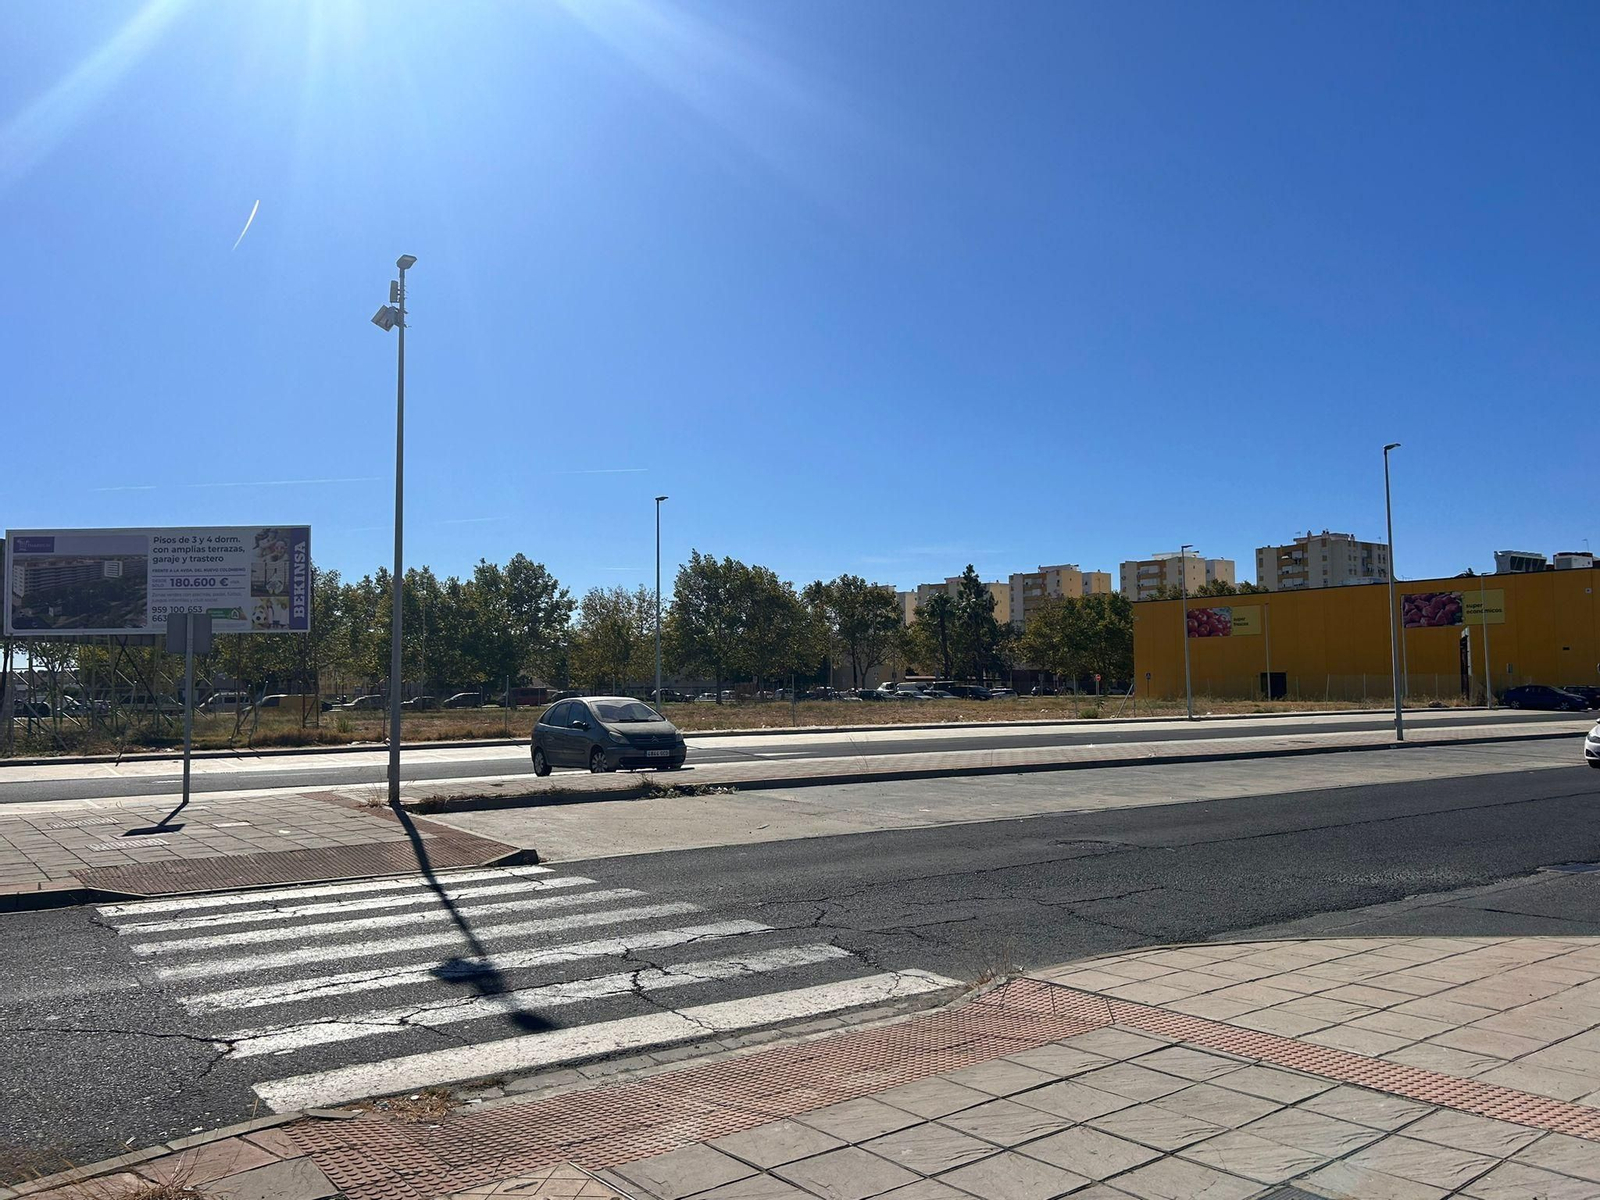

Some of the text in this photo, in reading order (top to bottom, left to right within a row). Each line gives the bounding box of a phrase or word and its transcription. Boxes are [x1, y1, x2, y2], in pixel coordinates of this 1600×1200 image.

[171, 546, 206, 554] amplias
[153, 556, 180, 564] garaje
[170, 578, 215, 587] 180.600
[220, 578, 228, 586] €
[294, 541, 305, 618] BEKINSA
